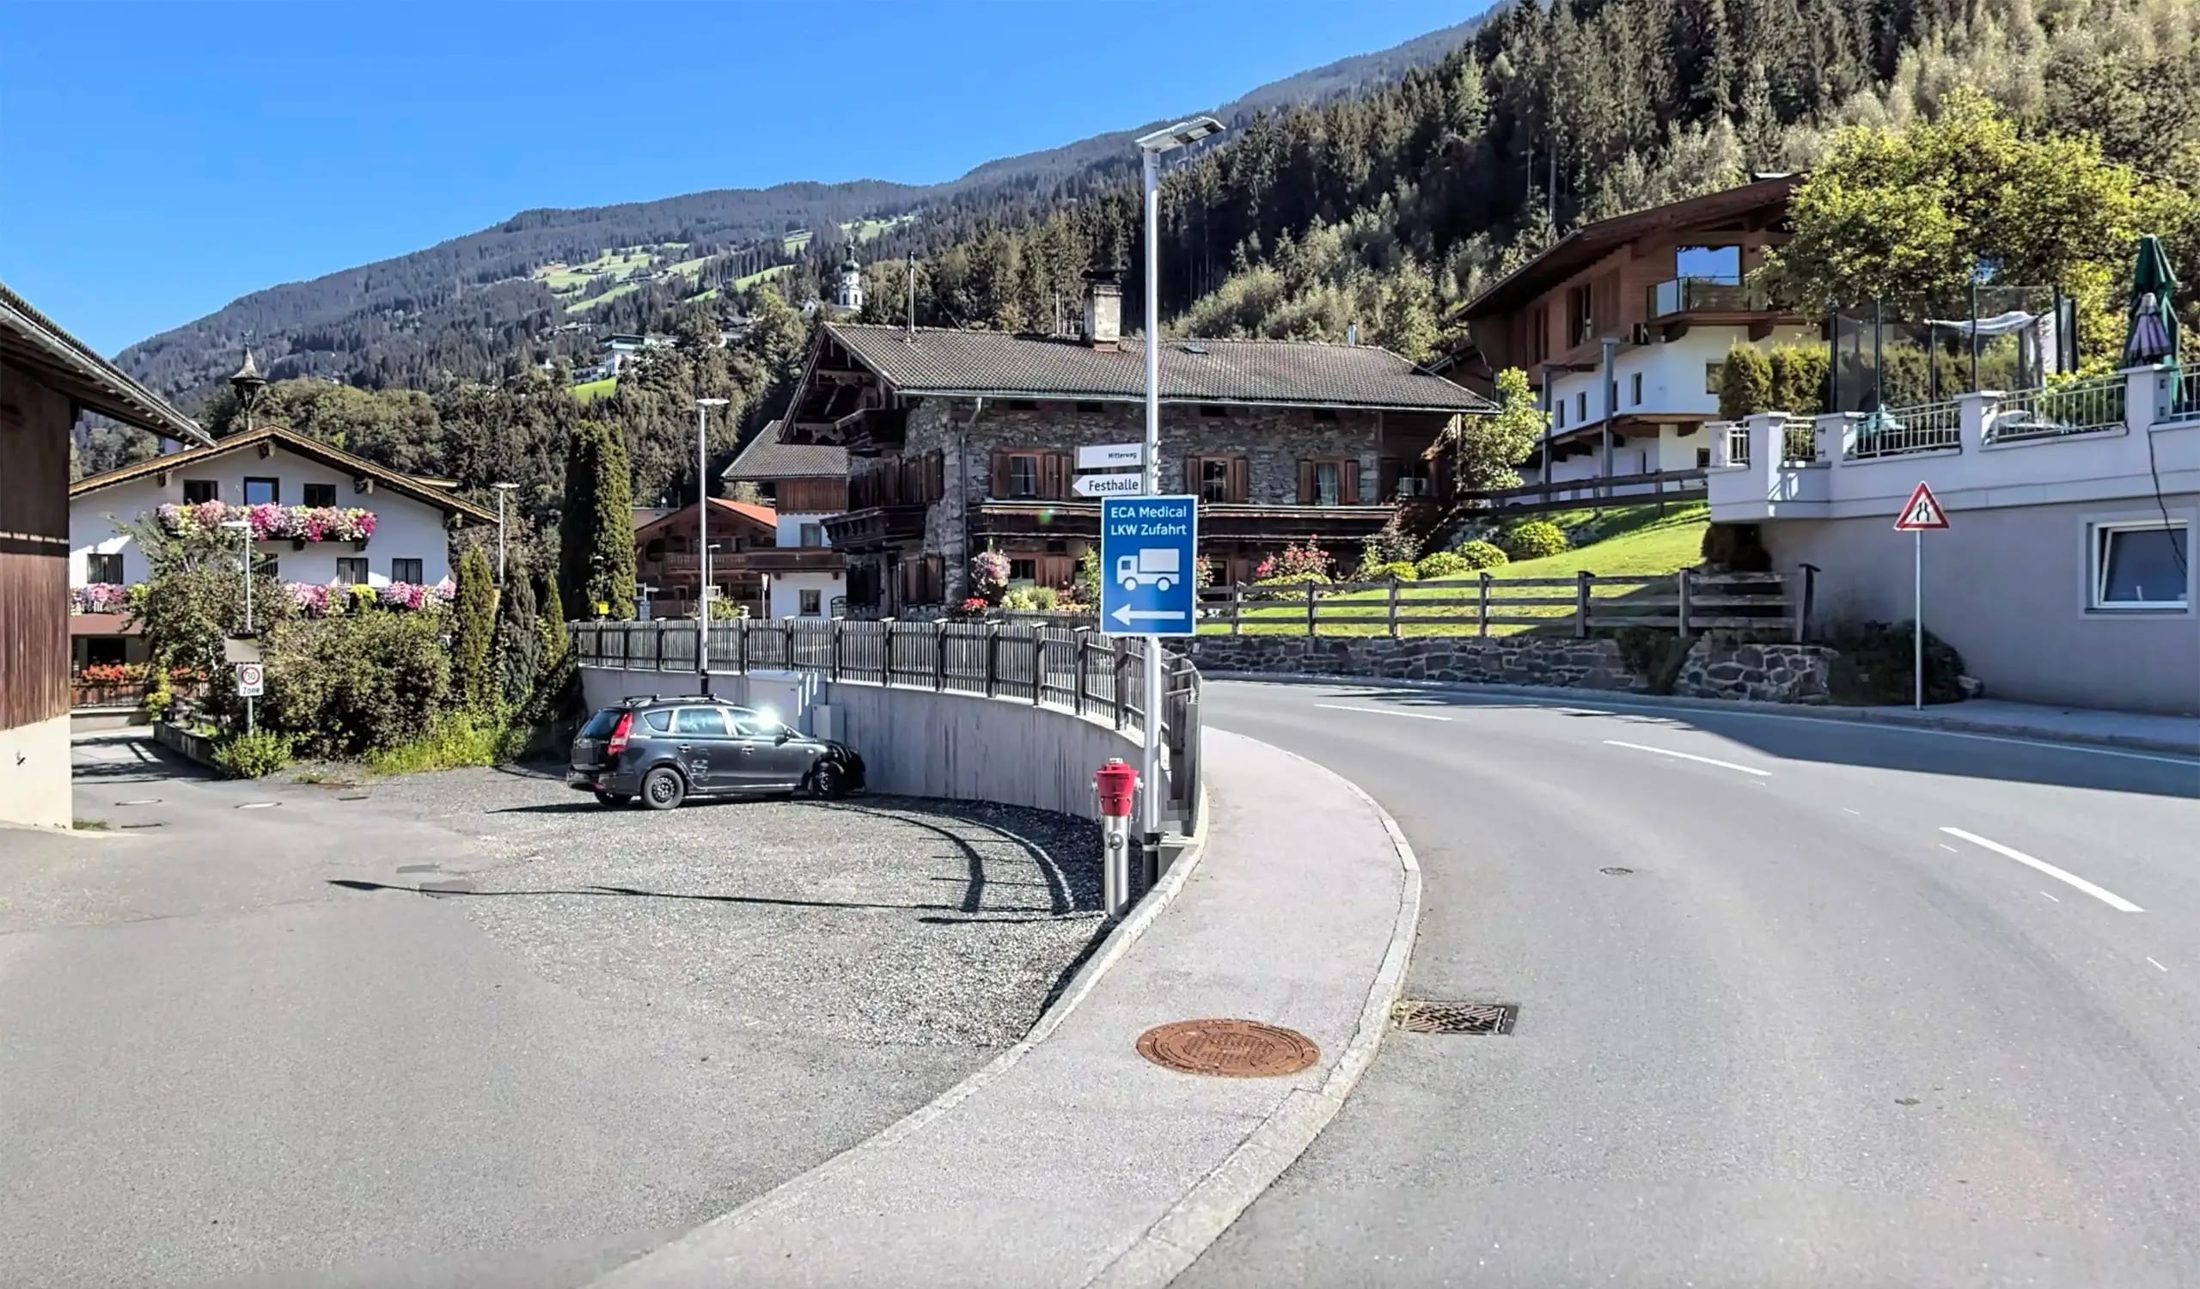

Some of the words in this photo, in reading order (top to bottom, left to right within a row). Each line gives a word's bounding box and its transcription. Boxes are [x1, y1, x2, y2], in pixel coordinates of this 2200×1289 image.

[1088, 479, 1138, 491] Festhalle
[1110, 507, 1136, 518] ECA
[1139, 505, 1187, 518] Medical
[1110, 524, 1138, 536] LKW
[1140, 523, 1187, 536] Zufahrt
[245, 671, 255, 680] 30
[243, 686, 260, 695] Zone
